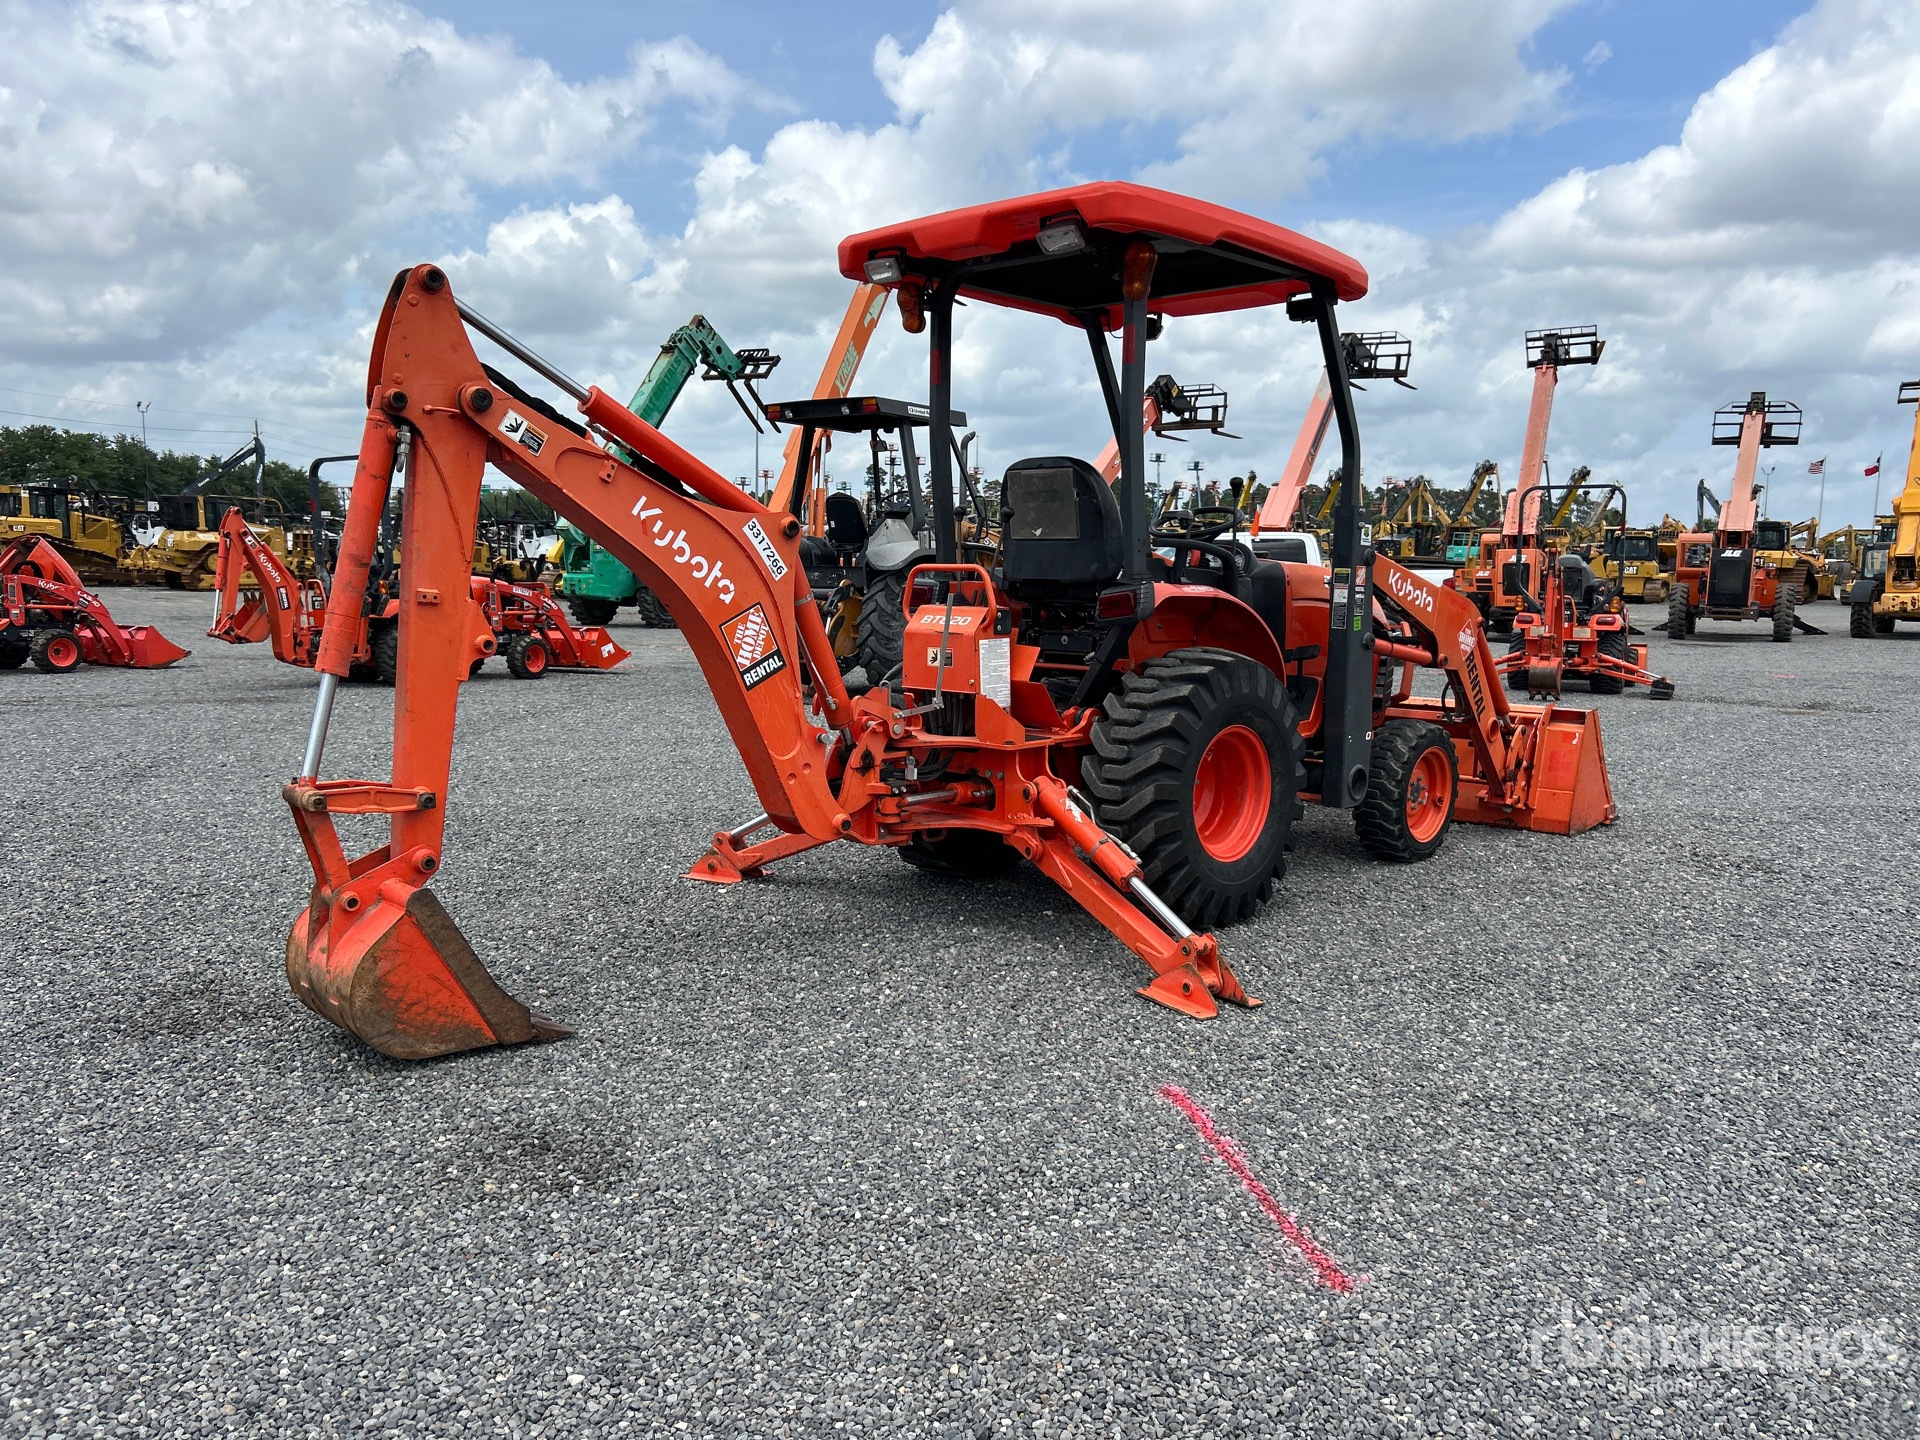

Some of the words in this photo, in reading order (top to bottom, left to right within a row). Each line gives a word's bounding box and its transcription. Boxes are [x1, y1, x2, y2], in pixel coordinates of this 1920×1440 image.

[259, 553, 281, 583] Kubota
[631, 495, 735, 605] Kubota
[748, 520, 785, 575] 3317266
[1388, 568, 1433, 613] Kubota
[1624, 566, 1637, 574] CAT
[733, 622, 746, 645] THE
[737, 609, 763, 666] HOME
[752, 622, 770, 660] DEPOT
[743, 655, 783, 686] RENTAL
[1465, 650, 1486, 721] RENTAL
